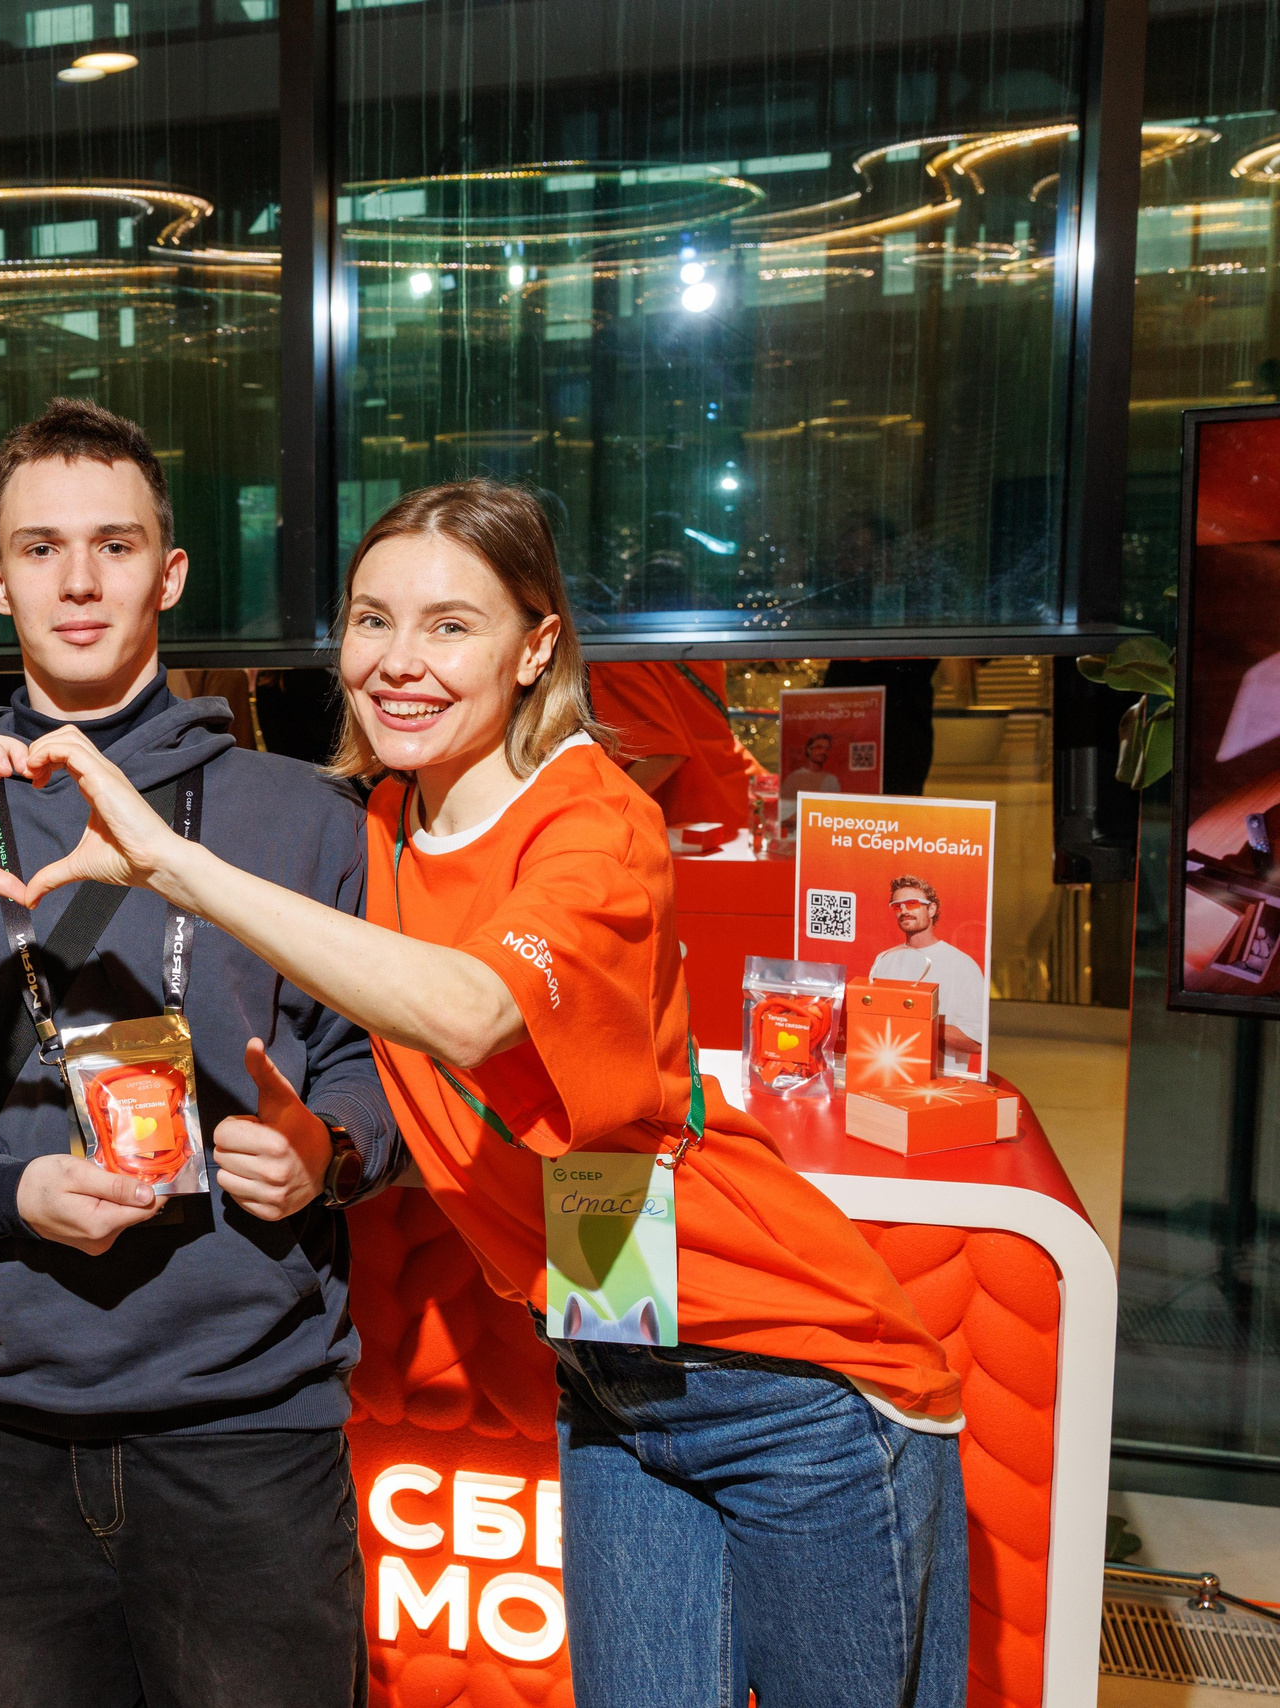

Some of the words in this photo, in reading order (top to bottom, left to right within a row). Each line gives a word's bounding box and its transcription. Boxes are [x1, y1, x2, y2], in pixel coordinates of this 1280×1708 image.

[808, 811, 899, 834] Переходи
[831, 834, 853, 847] на
[857, 833, 983, 857] СберМобайл
[767, 1013, 788, 1023] Теперь
[570, 1171, 603, 1181] СБЕР
[561, 1190, 665, 1216] Стася
[378, 1555, 567, 1662] МО
